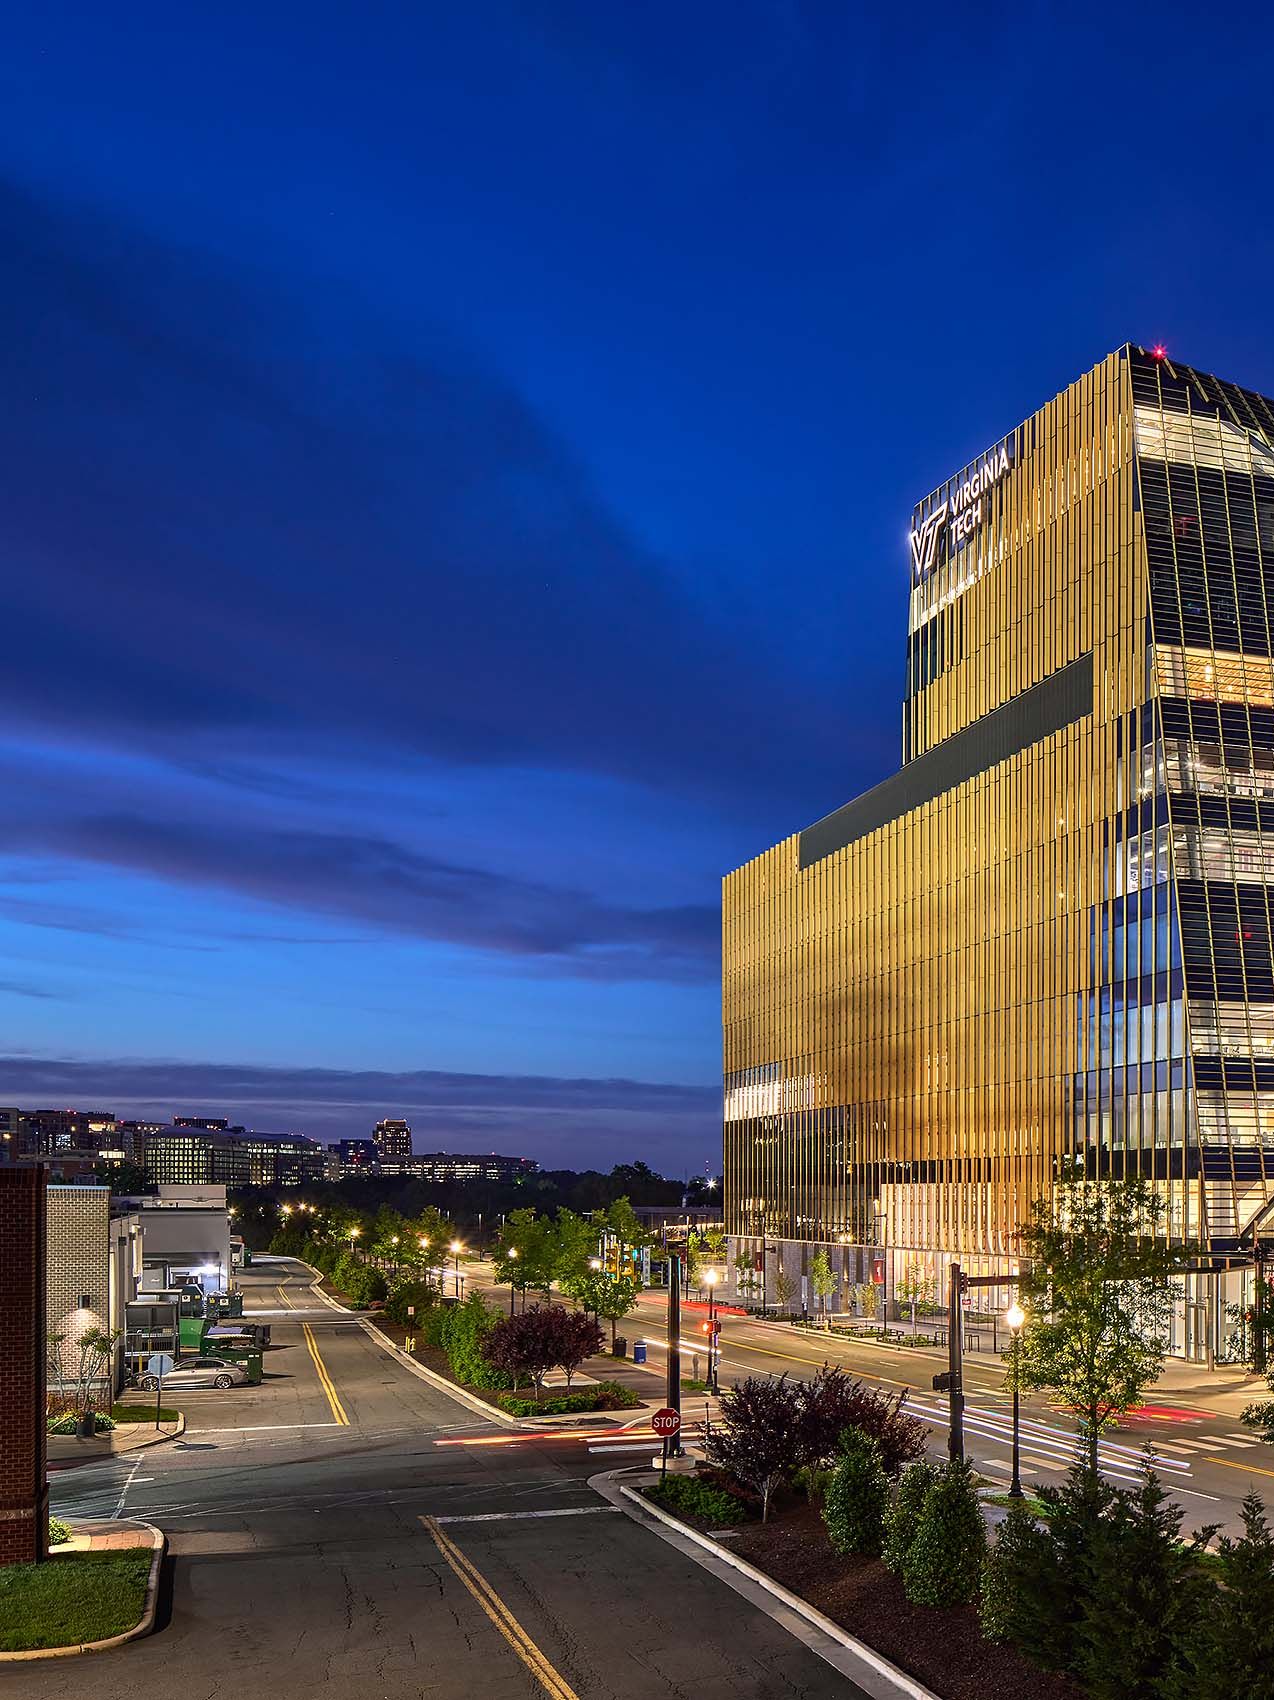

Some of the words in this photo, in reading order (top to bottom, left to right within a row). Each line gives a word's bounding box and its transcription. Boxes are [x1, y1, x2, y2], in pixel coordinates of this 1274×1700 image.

[951, 447, 1009, 516] VIRGINIA
[911, 501, 948, 575] VT
[951, 499, 981, 545] TECH
[653, 1416, 680, 1428] STOP
